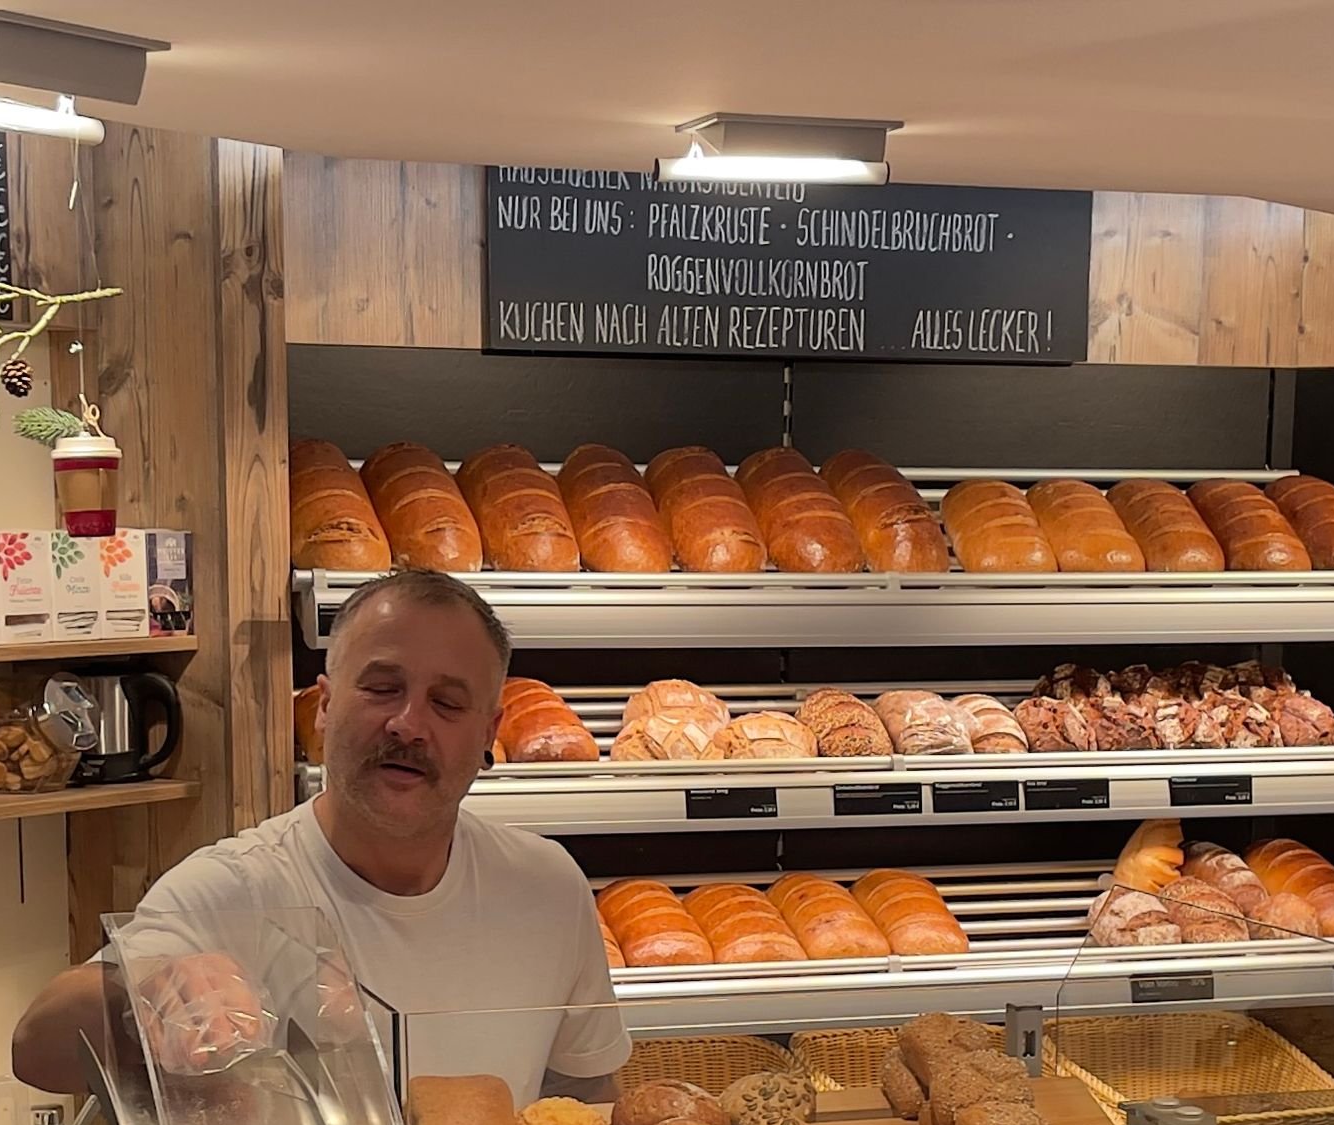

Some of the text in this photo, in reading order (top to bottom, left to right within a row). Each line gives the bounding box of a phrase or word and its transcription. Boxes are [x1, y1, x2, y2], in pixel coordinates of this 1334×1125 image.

[498, 196, 541, 230] NUR
[549, 196, 578, 232] BEI
[648, 203, 772, 246] PFALZKRUSTE
[796, 208, 999, 253] SCHINDELBRUCHBROT
[648, 253, 868, 301] ROGGENVOLLKORNBROT
[498, 300, 585, 345] KUCHEN
[595, 302, 647, 346] NACH
[657, 304, 718, 349] ALTEN
[728, 305, 865, 352] REZEPTUREN
[911, 309, 964, 351] ALLES
